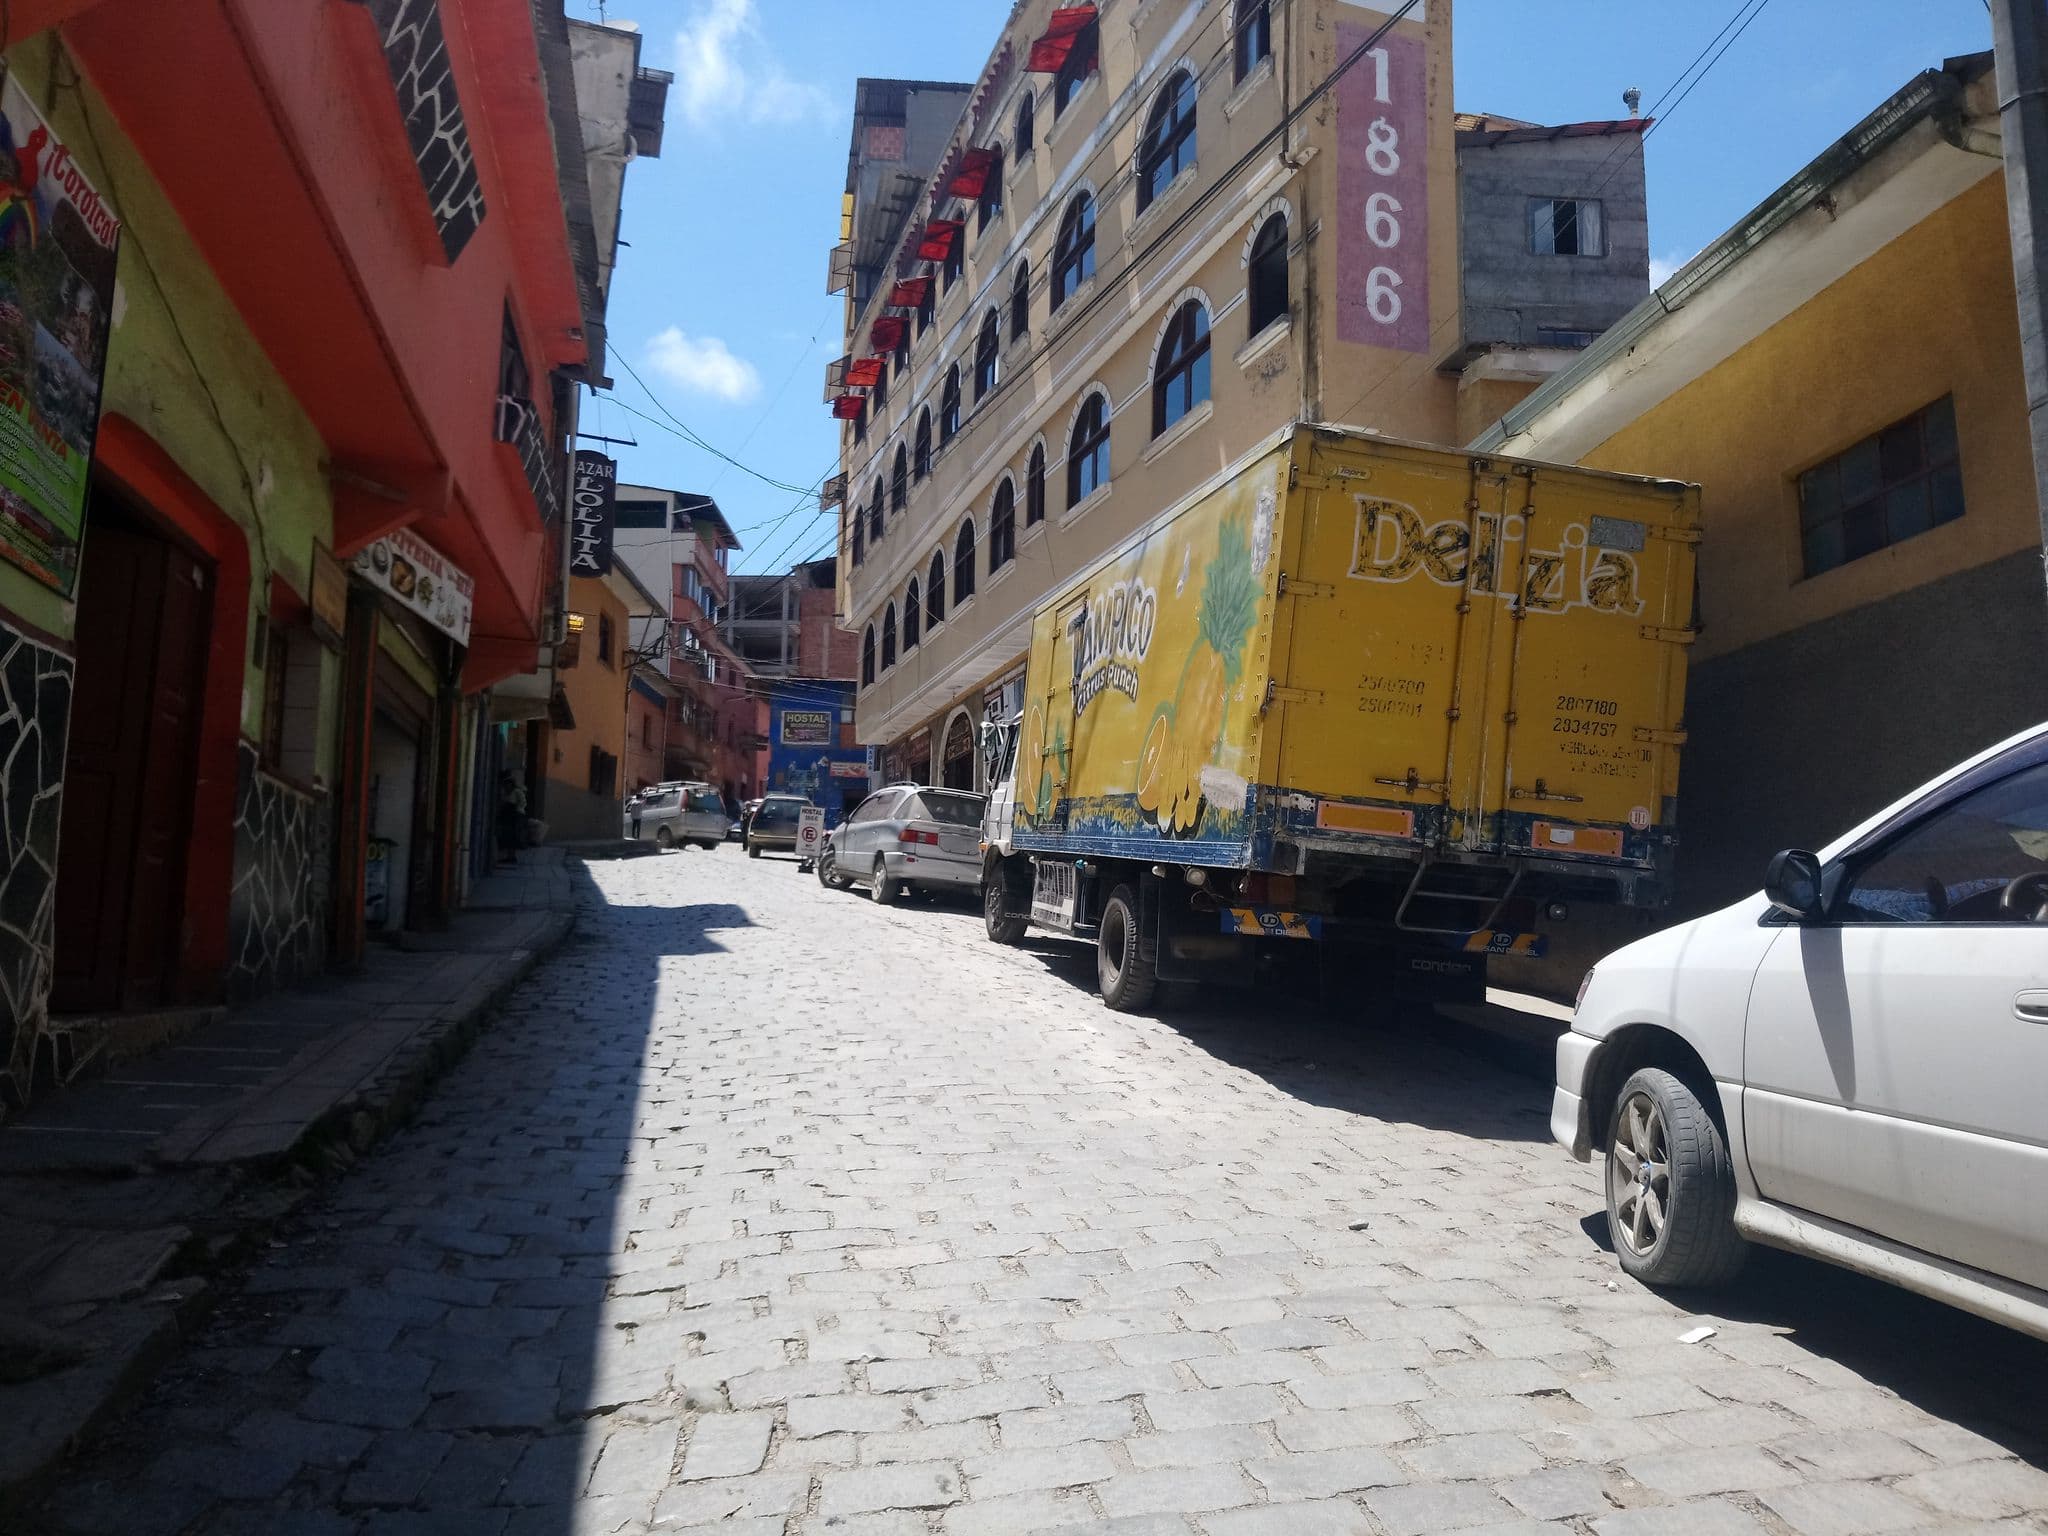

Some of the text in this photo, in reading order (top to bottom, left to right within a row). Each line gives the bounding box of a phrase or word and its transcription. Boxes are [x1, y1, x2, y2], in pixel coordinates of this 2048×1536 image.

[575, 460, 615, 479] AZAR
[571, 476, 604, 570] LOLITA
[1346, 493, 1647, 616] Delizia
[1556, 696, 1618, 717] 2807180
[786, 714, 826, 724] HOSTAL
[1553, 717, 1617, 737] 2834757
[801, 808, 823, 816] HOSTAL
